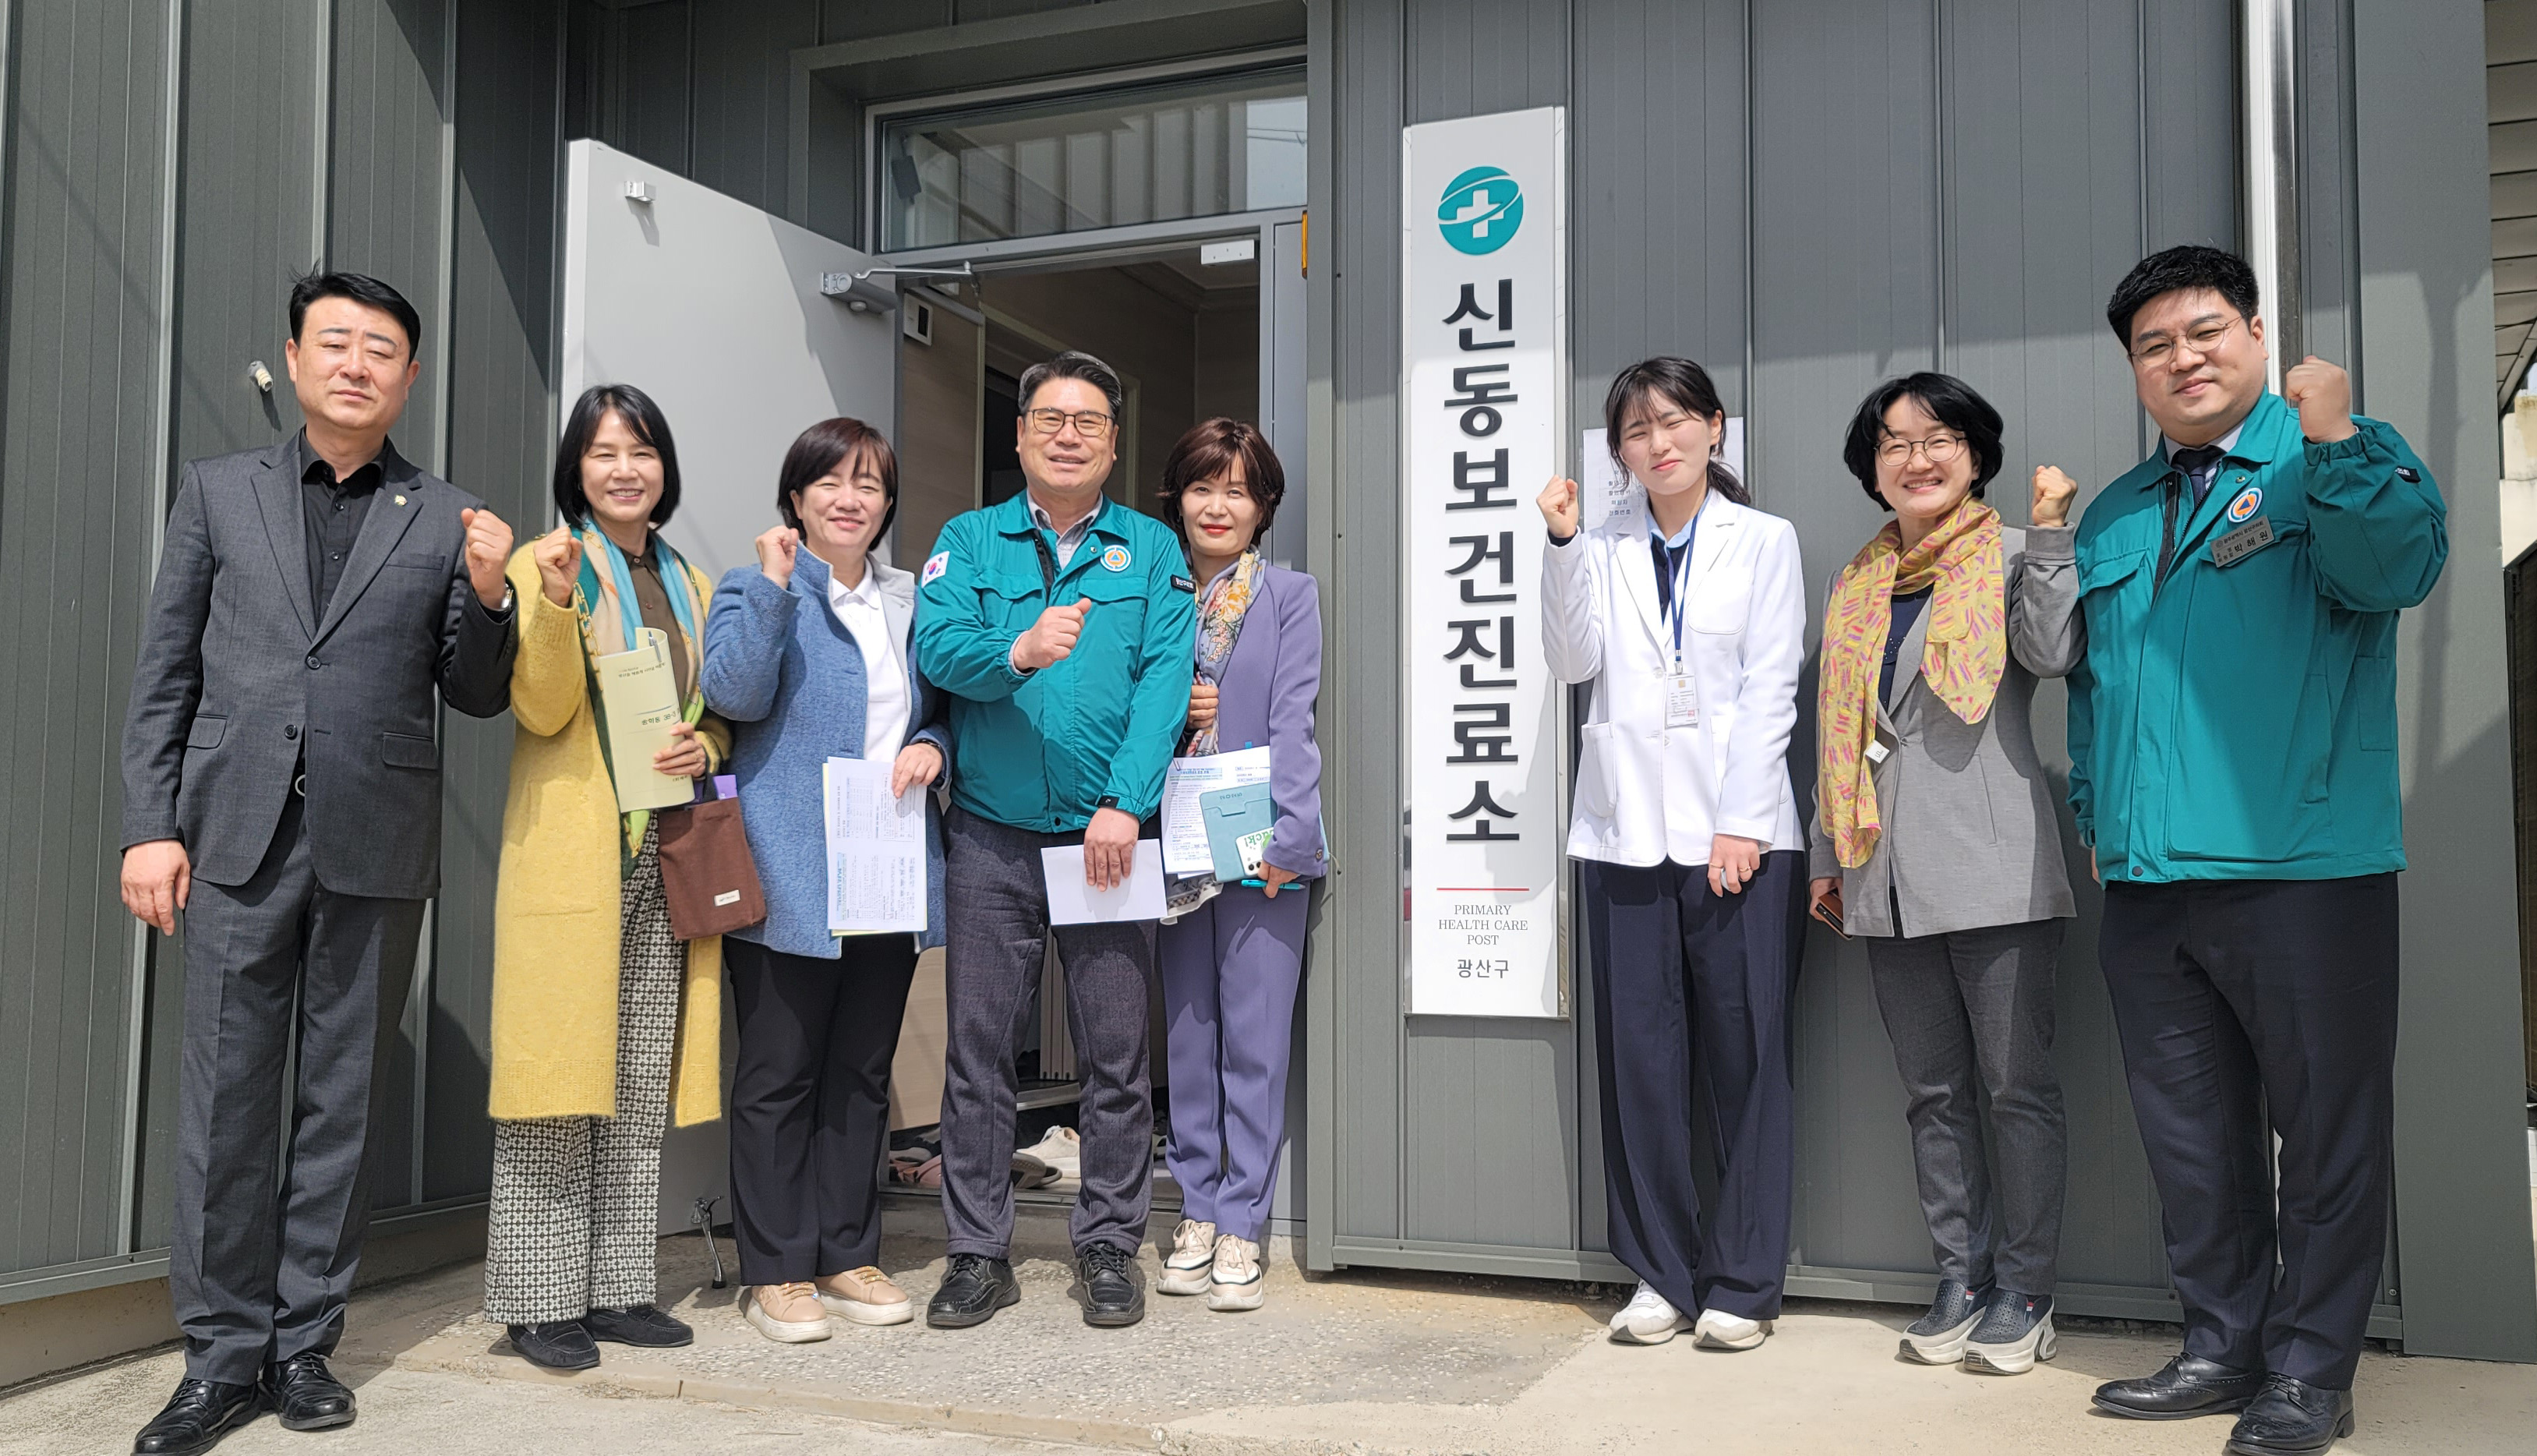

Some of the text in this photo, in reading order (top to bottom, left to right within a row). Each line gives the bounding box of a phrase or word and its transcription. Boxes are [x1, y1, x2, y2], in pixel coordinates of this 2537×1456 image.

[2234, 530, 2269, 553] 박해원
[1442, 278, 1520, 842] 신동보건진료소
[1454, 904, 1511, 915] PRIMARY
[1439, 919, 1528, 931] HEALTH CARE
[1467, 935, 1500, 945] POST
[1458, 959, 1509, 979] 광산구
